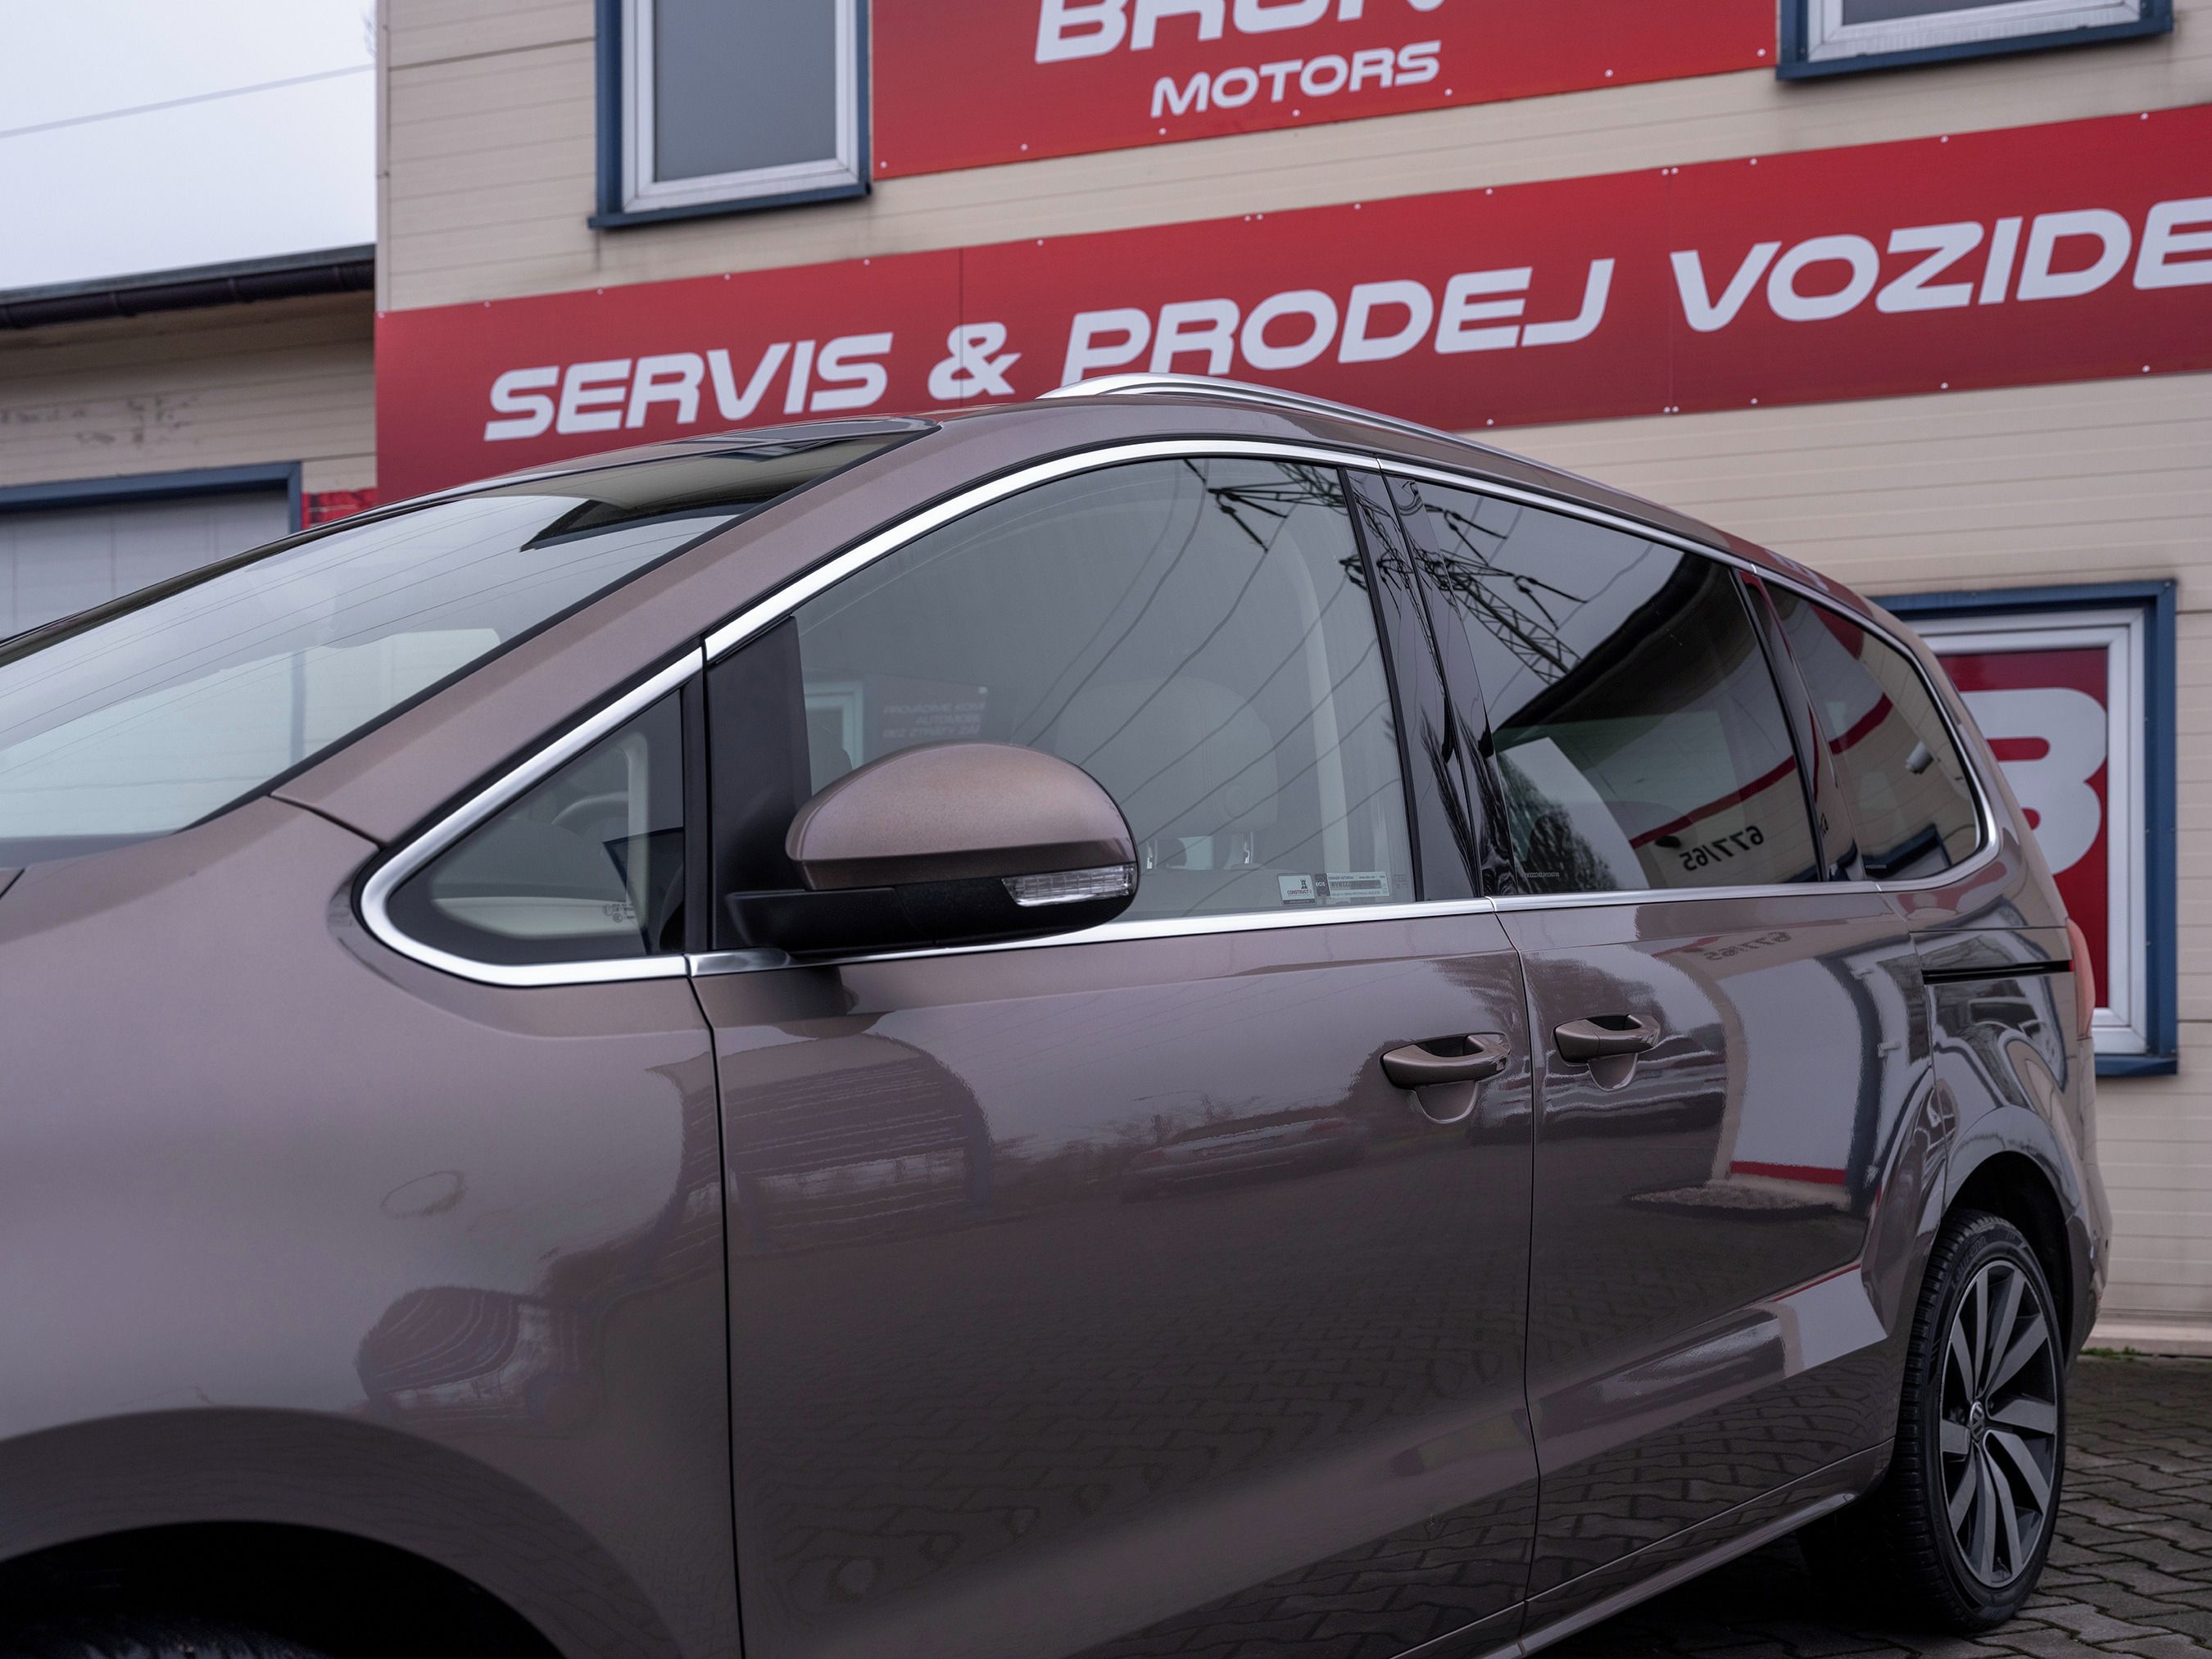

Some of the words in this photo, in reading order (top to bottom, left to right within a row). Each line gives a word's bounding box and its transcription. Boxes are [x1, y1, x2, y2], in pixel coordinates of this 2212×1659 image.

[1151, 40, 1440, 117] MOTORS
[484, 333, 893, 441] SERVIS
[927, 322, 1022, 400] &
[1061, 258, 1615, 388] PRODEJ
[1670, 196, 2212, 332] VOZIDE
